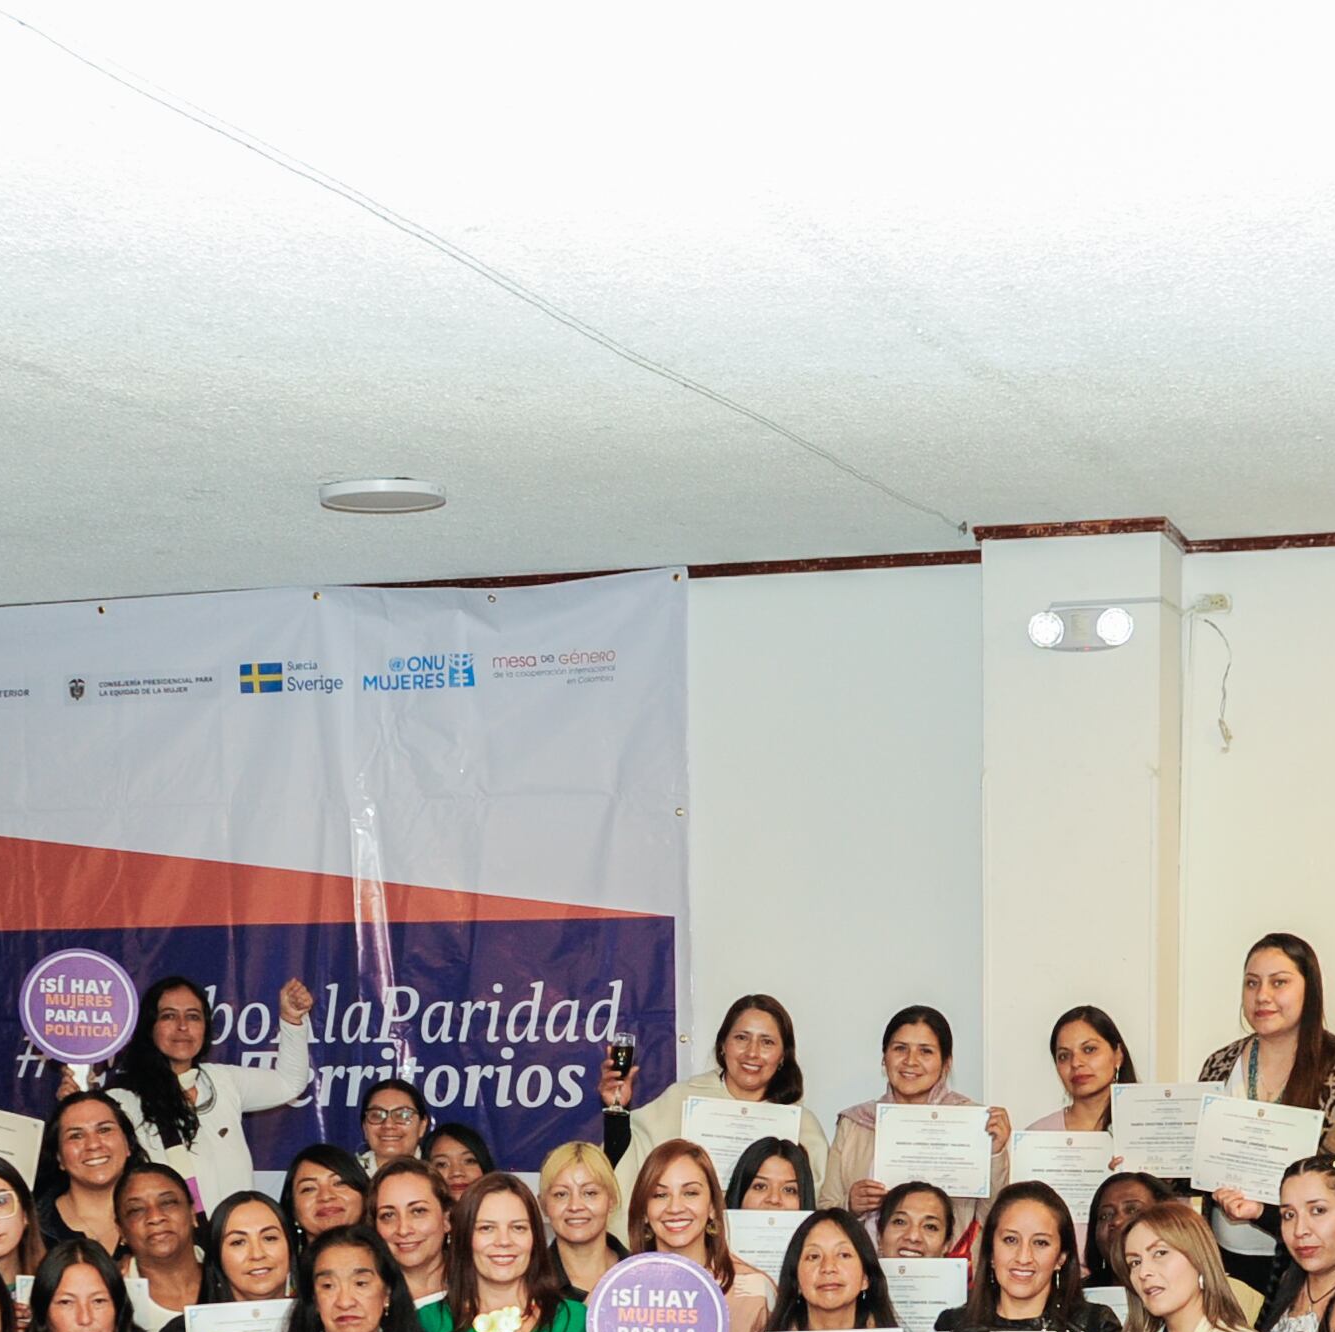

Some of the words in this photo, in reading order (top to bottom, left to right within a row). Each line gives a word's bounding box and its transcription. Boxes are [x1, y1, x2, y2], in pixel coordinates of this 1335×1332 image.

[287, 661, 318, 671] Suecia
[407, 655, 444, 672] ONU
[493, 656, 537, 668] mesa
[287, 675, 343, 694] Sverige
[365, 674, 445, 691] MUJERES
[40, 975, 66, 994] ¡SÍ
[71, 979, 113, 995] HAY
[45, 994, 113, 1008] MUJERES
[45, 1009, 88, 1023] PARA
[93, 1011, 113, 1024] LA
[45, 1022, 118, 1037] POLÍTICA!
[611, 1284, 642, 1307] ¡SÍ
[649, 1289, 698, 1308] HAY
[618, 1308, 698, 1326] MUJERES
